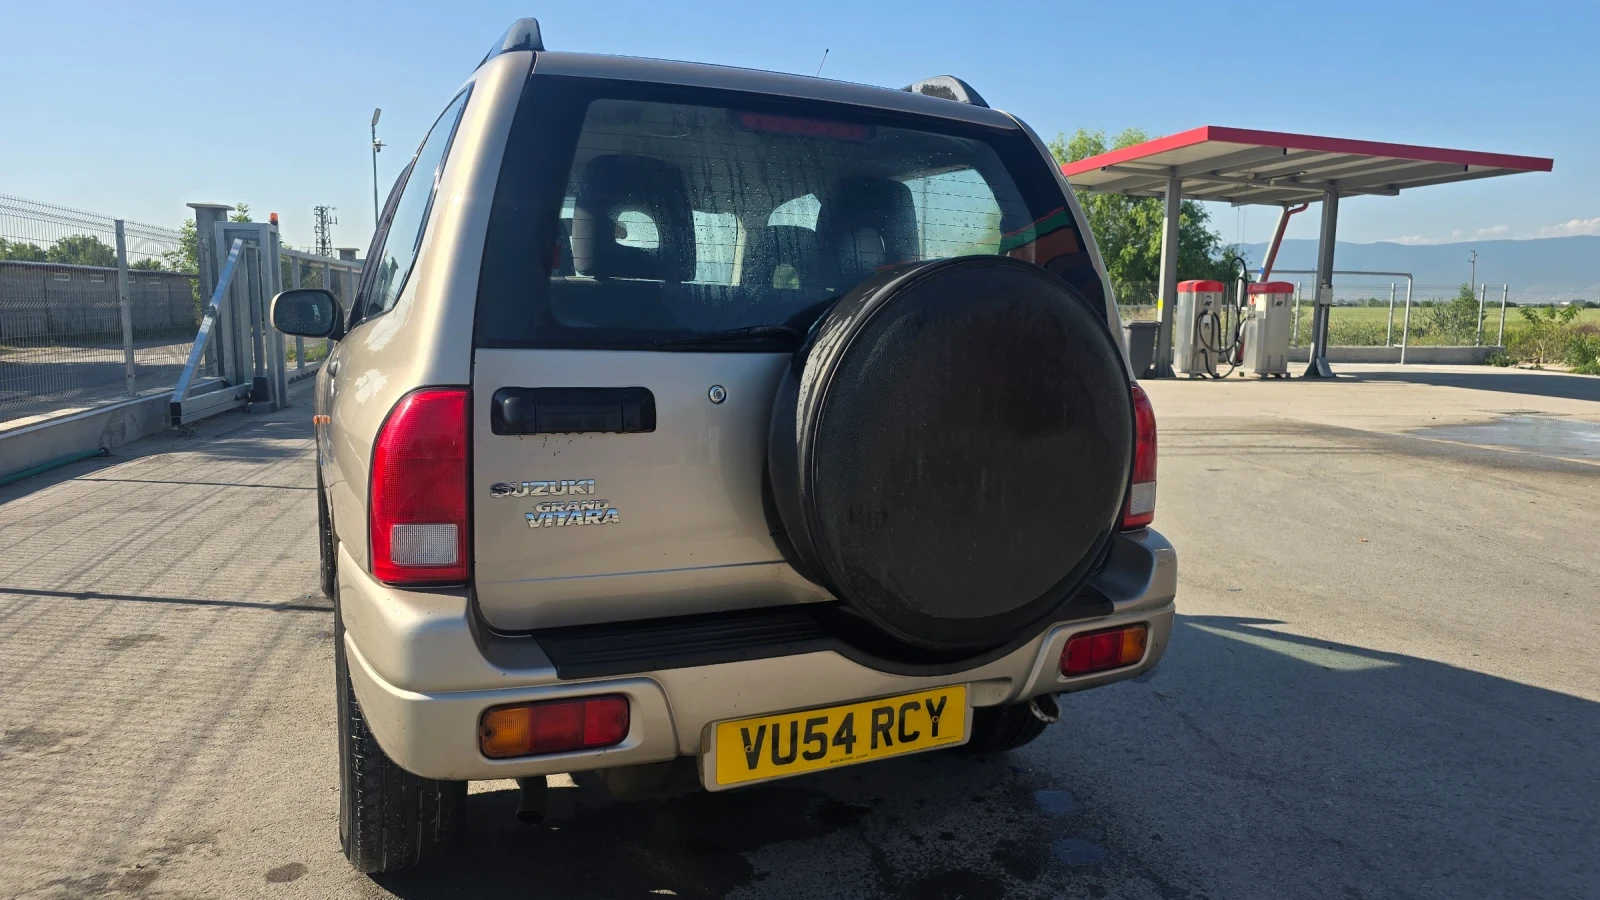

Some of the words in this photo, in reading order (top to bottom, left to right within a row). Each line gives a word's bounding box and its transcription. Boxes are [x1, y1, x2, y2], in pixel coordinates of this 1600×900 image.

[490, 479, 595, 498] SUZUKI
[535, 499, 610, 512] GRAND
[525, 508, 620, 528] VITARA
[740, 712, 857, 770] VU54
[870, 695, 947, 750] RCY
